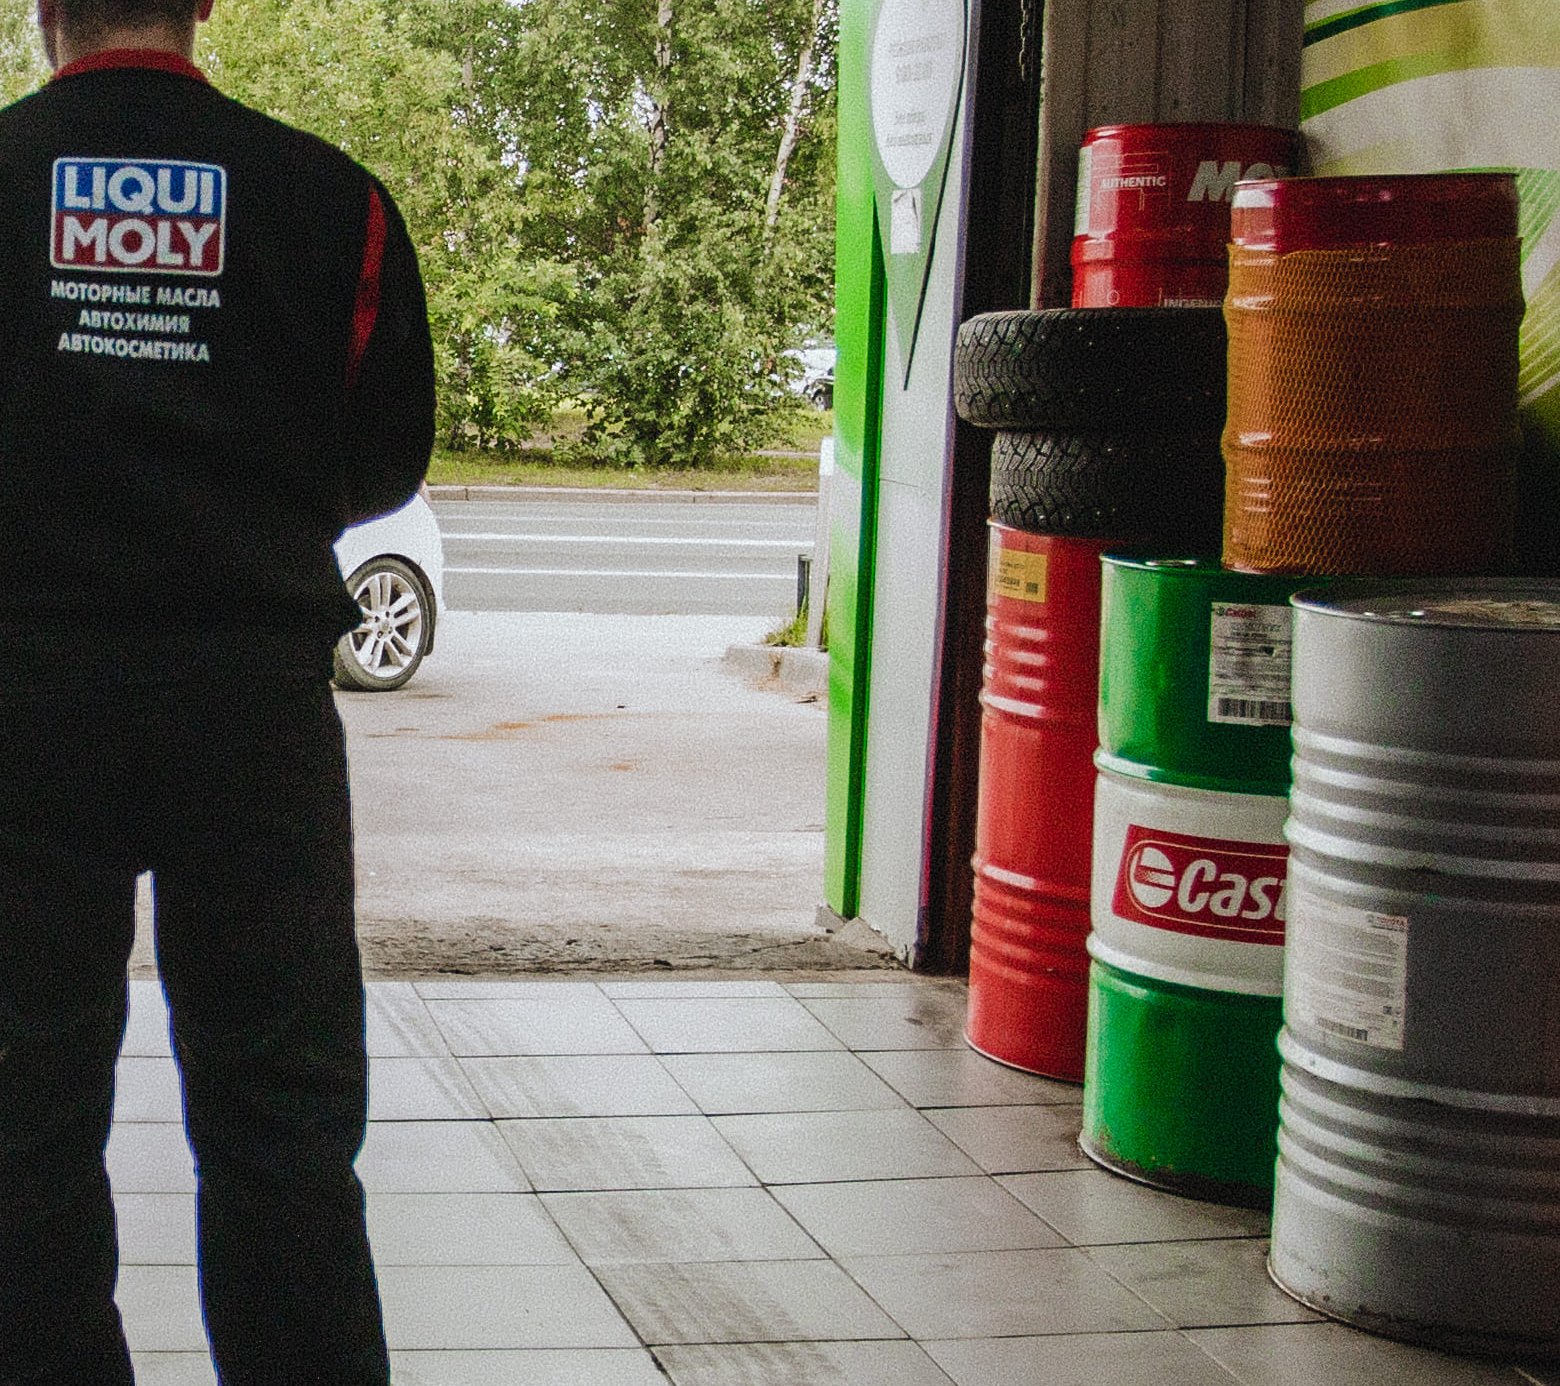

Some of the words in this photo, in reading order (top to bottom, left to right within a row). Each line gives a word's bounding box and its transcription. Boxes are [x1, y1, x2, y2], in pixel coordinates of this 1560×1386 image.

[64, 165, 214, 215] LIQUI
[1101, 175, 1167, 189] AUTHENTIC
[63, 216, 218, 266] MOLY
[51, 280, 151, 304] МОТОРНЫЕ
[156, 288, 220, 308] МАСЛА
[79, 310, 190, 333] АВТОХИМИЯ
[57, 332, 210, 362] АВТОКОСМЕТИКА
